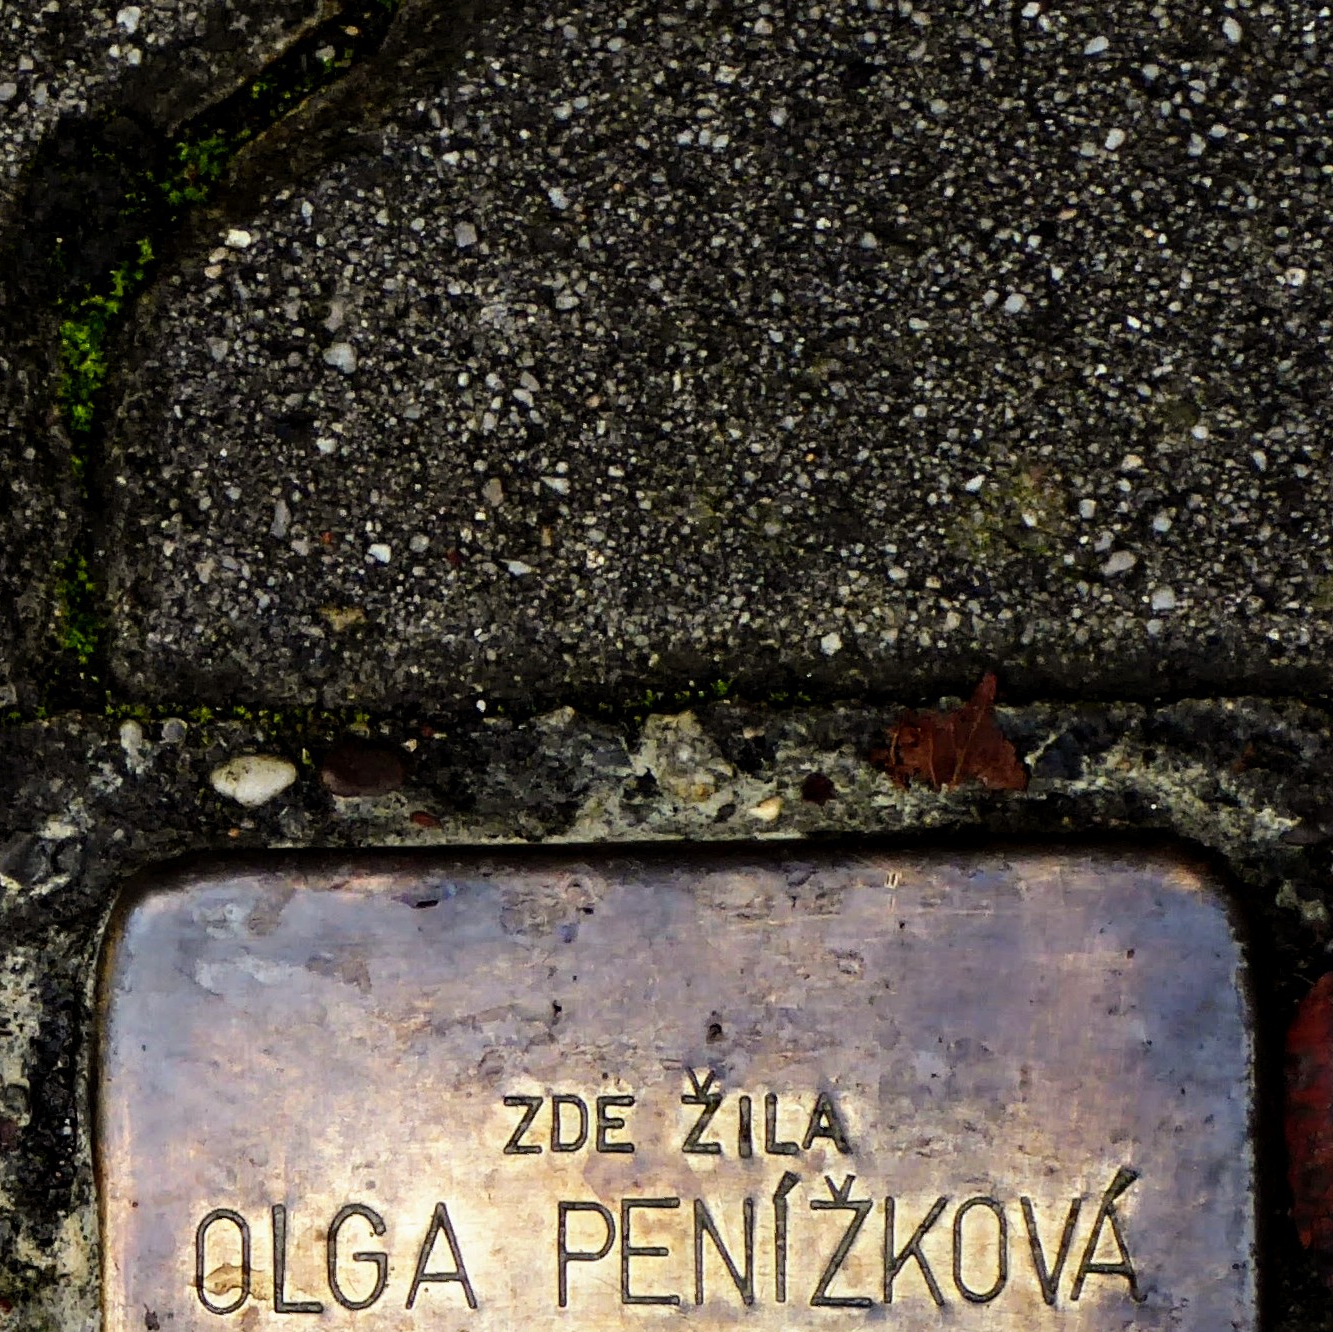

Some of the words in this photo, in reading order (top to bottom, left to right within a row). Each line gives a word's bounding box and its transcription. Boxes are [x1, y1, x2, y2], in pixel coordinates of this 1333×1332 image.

[503, 1094, 637, 1157] ZDE
[681, 1068, 851, 1157] ŽILA
[192, 1199, 479, 1317] OLGA
[556, 1167, 1143, 1310] PENÍŽKOVÁ
